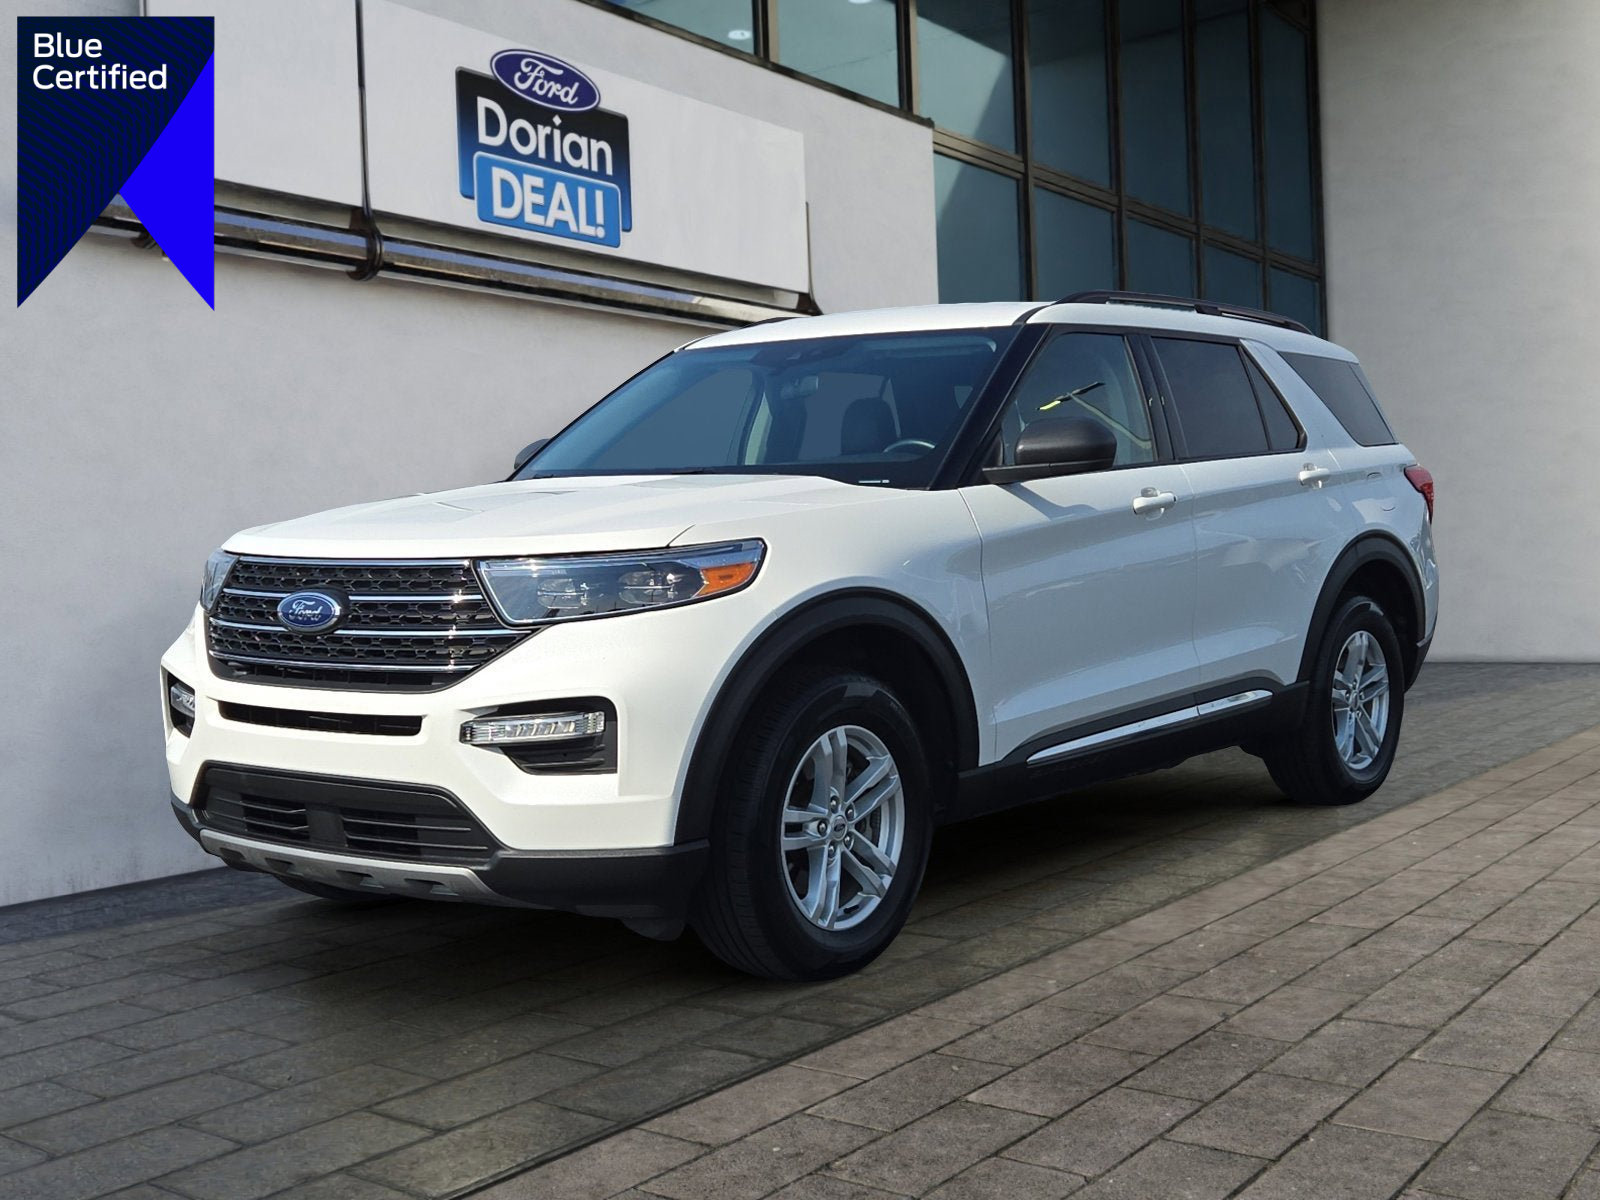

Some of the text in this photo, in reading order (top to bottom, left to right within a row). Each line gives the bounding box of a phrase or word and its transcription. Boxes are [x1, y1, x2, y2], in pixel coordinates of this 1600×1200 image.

[514, 57, 580, 105] Ford
[476, 95, 614, 176] Dorian
[491, 165, 606, 239] DEAL!
[288, 599, 323, 621] Ford
